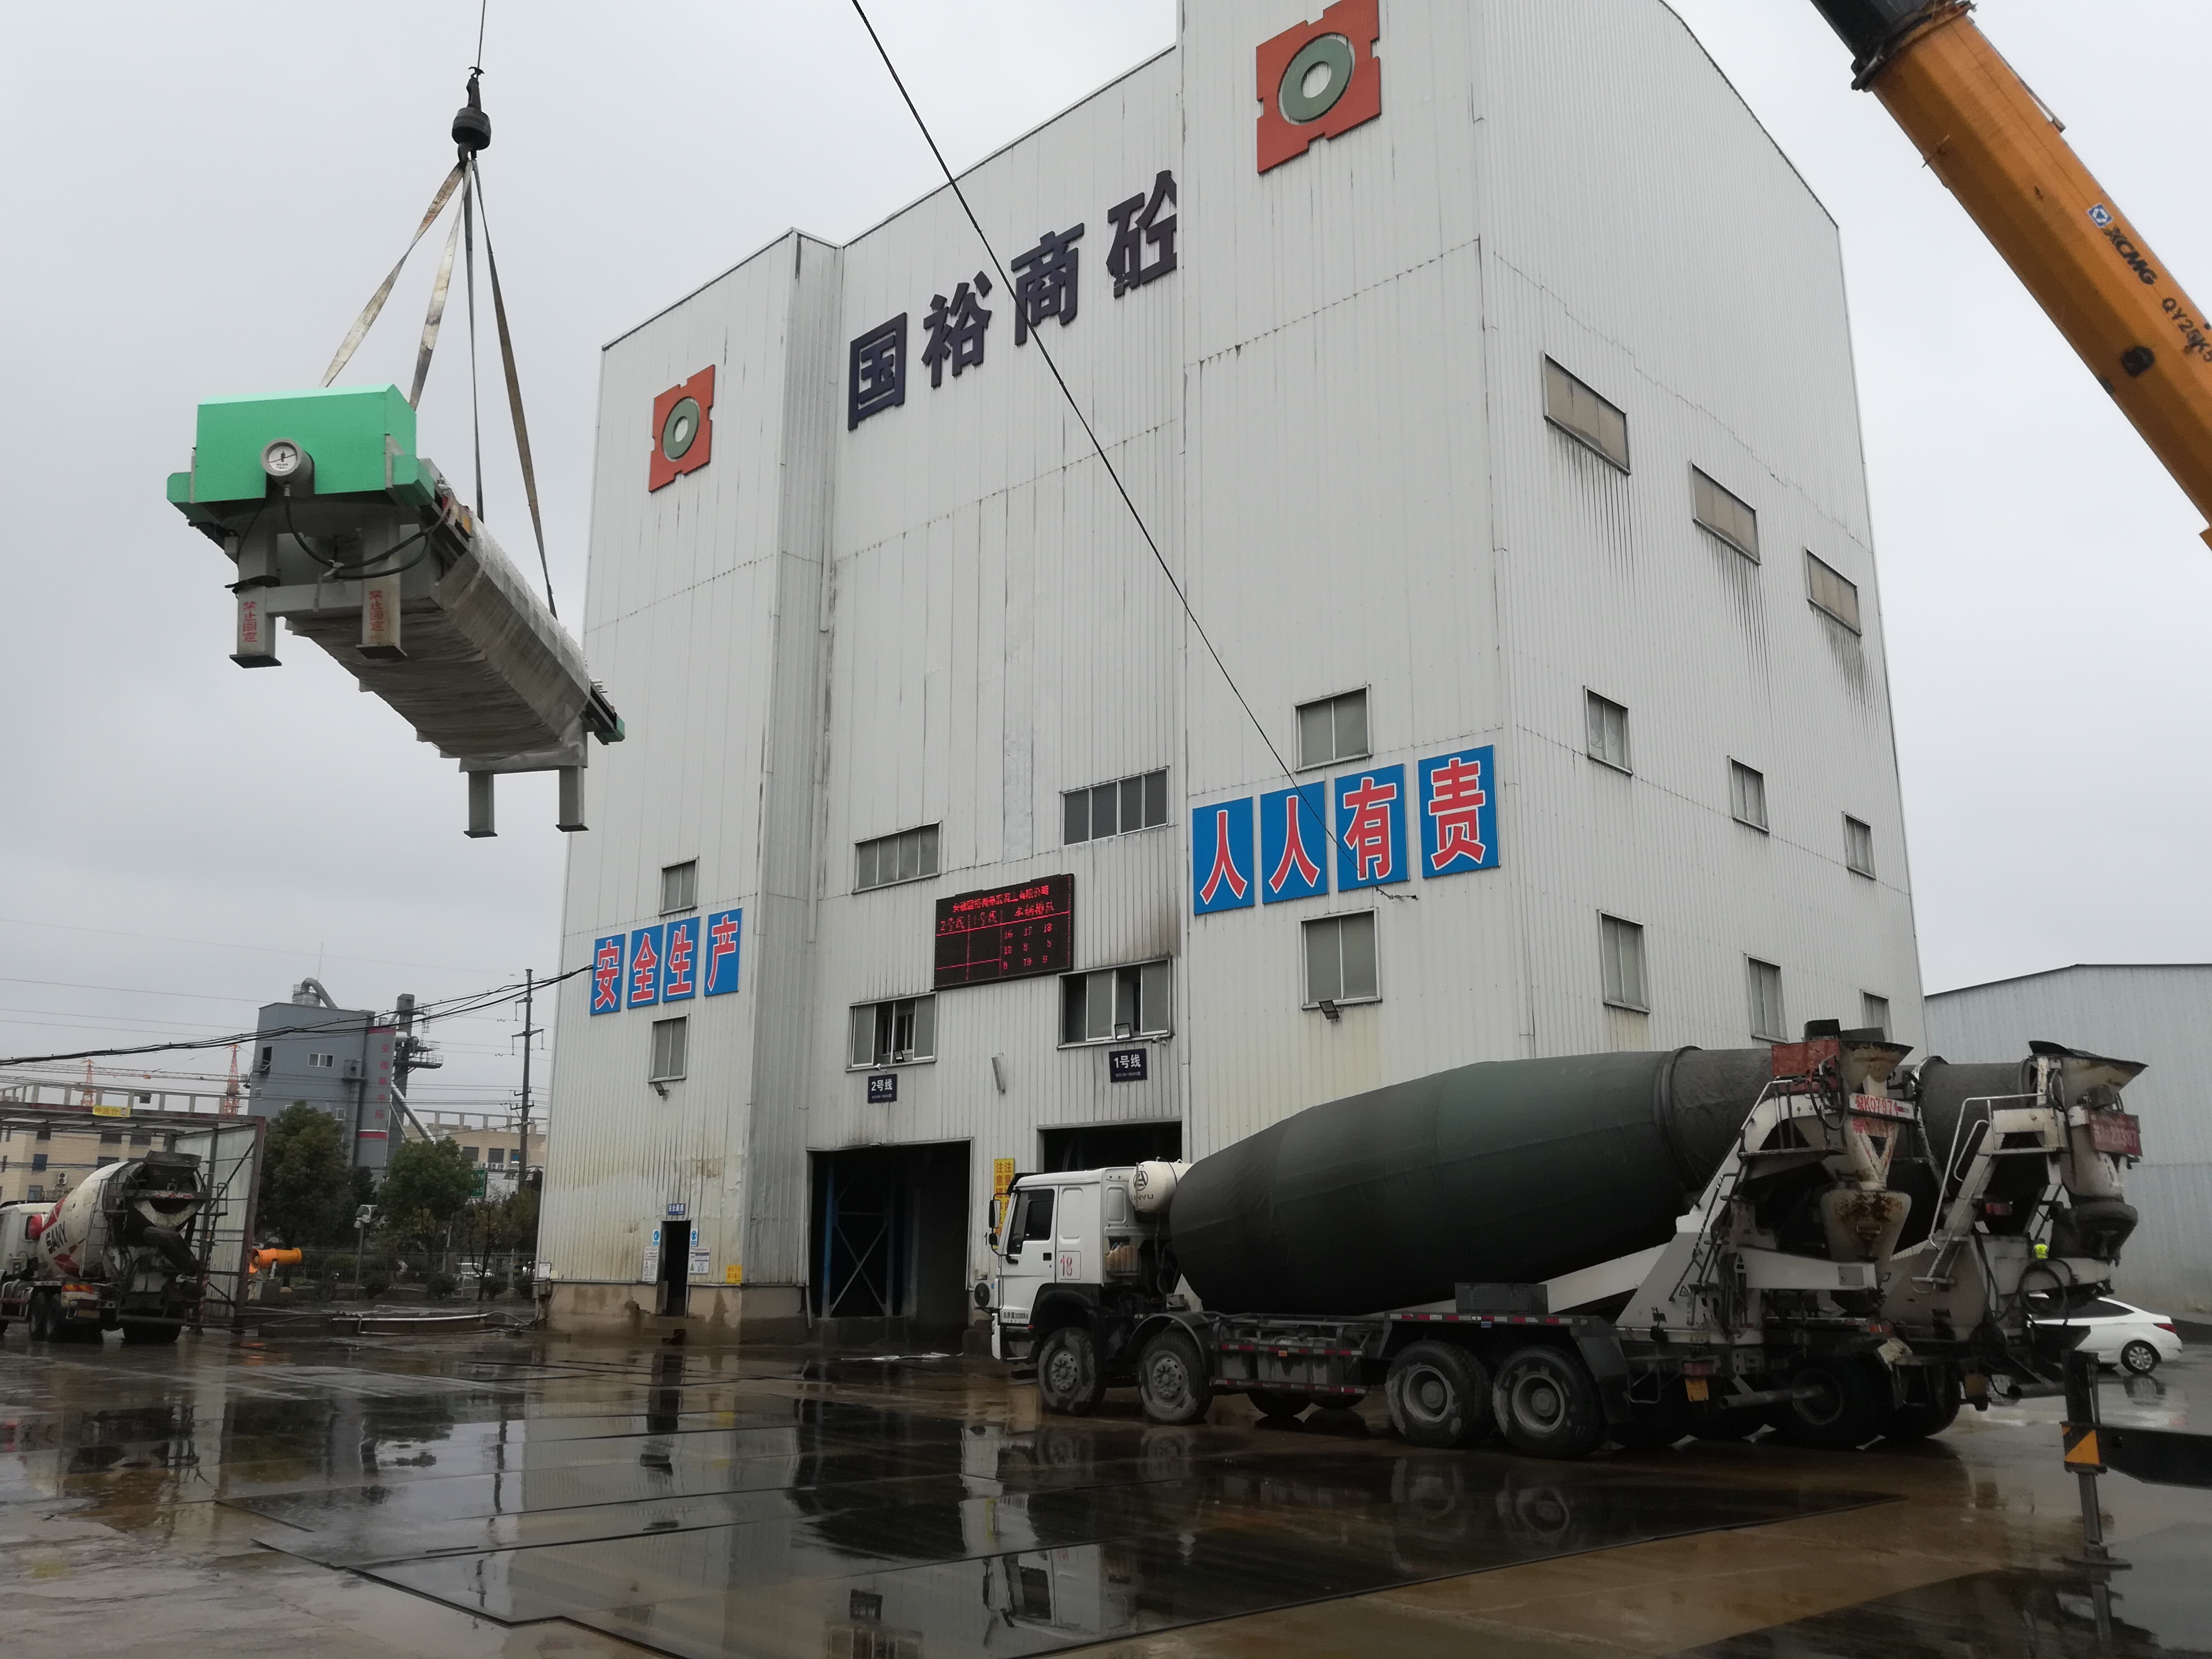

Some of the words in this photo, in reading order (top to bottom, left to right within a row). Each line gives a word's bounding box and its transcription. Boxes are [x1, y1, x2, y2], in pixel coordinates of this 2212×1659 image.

[2101, 225, 2157, 285] XCMG
[848, 169, 1177, 431] 国裕商砼
[1200, 757, 1486, 905] 人人有责
[595, 914, 738, 1010] 安全生产
[1114, 1054, 1141, 1068] 1号线
[871, 1079, 892, 1091] 2号线
[46, 1221, 67, 1254] SANY
[1060, 1255, 1073, 1277] 18
